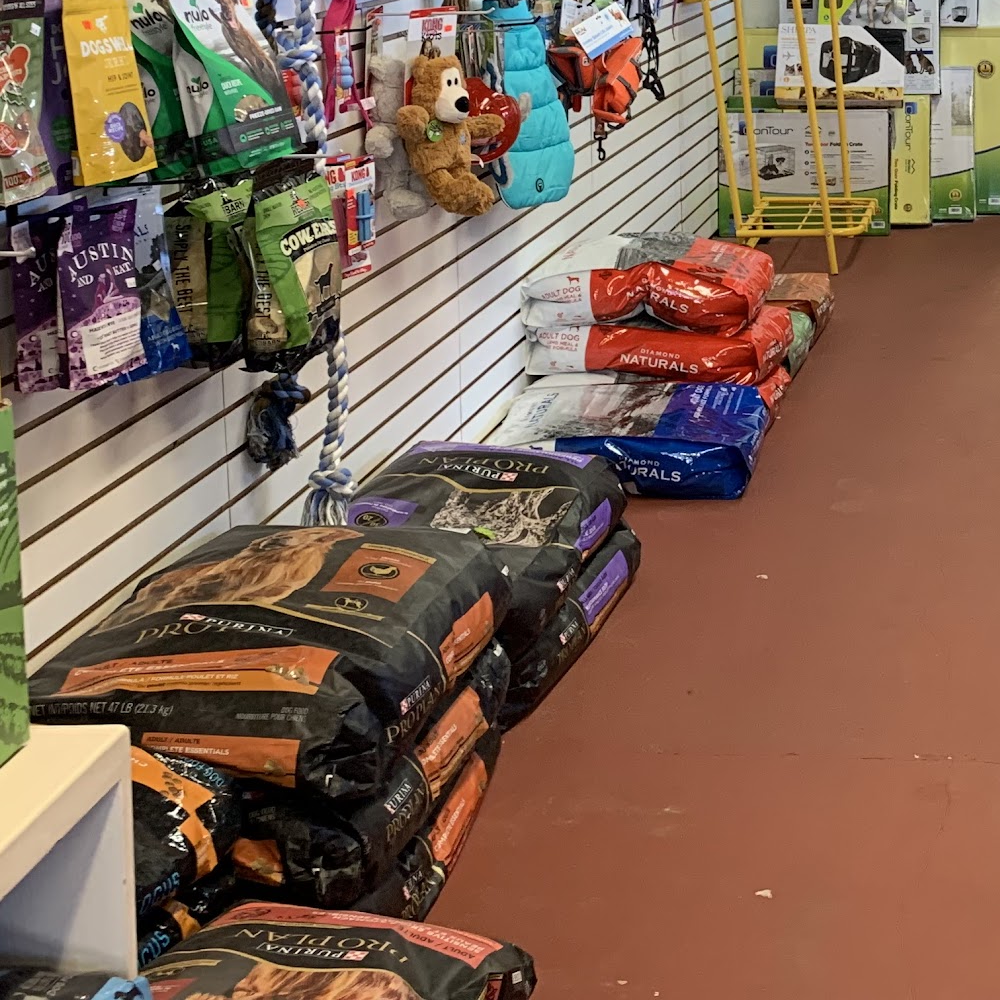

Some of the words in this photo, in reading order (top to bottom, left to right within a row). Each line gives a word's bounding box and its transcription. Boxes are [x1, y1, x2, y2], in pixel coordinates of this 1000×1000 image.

[130, 8, 163, 31] nulo
[183, 7, 211, 24] nulo
[422, 17, 444, 32] KONG
[186, 80, 210, 95] nulo
[351, 168, 365, 182] KONG
[280, 228, 314, 257] COW
[68, 241, 135, 284] AUSTIN
[77, 274, 95, 289] AND
[175, 265, 191, 286] THE
[176, 288, 194, 314] BEST
[540, 288, 561, 300] ADULT
[562, 285, 582, 294] DOG
[626, 283, 690, 314] NATRALS
[538, 332, 560, 341] ADULT
[560, 334, 581, 342] DOG
[640, 348, 681, 360] DIAMOND
[619, 353, 700, 375] NATURALS
[418, 455, 491, 468] PLAN
[494, 456, 550, 475] PRO
[441, 463, 499, 481] PURINA
[615, 462, 682, 483] ATURALS
[206, 614, 285, 636] PURINA
[186, 673, 214, 681] POULET
[407, 680, 431, 707] PURINA
[89, 701, 107, 714] NET
[108, 701, 119, 713] 47
[120, 702, 133, 714] LB
[134, 702, 157, 715] (21.3
[158, 703, 174, 717] kg)
[146, 735, 169, 744] ADULT
[175, 736, 201, 745] ADULTE
[184, 747, 230, 756] ESSENTIALS
[139, 871, 181, 915] OCUS
[234, 927, 334, 947] PLAN
[264, 942, 344, 961] PURINA
[442, 945, 476, 961] ADULT
